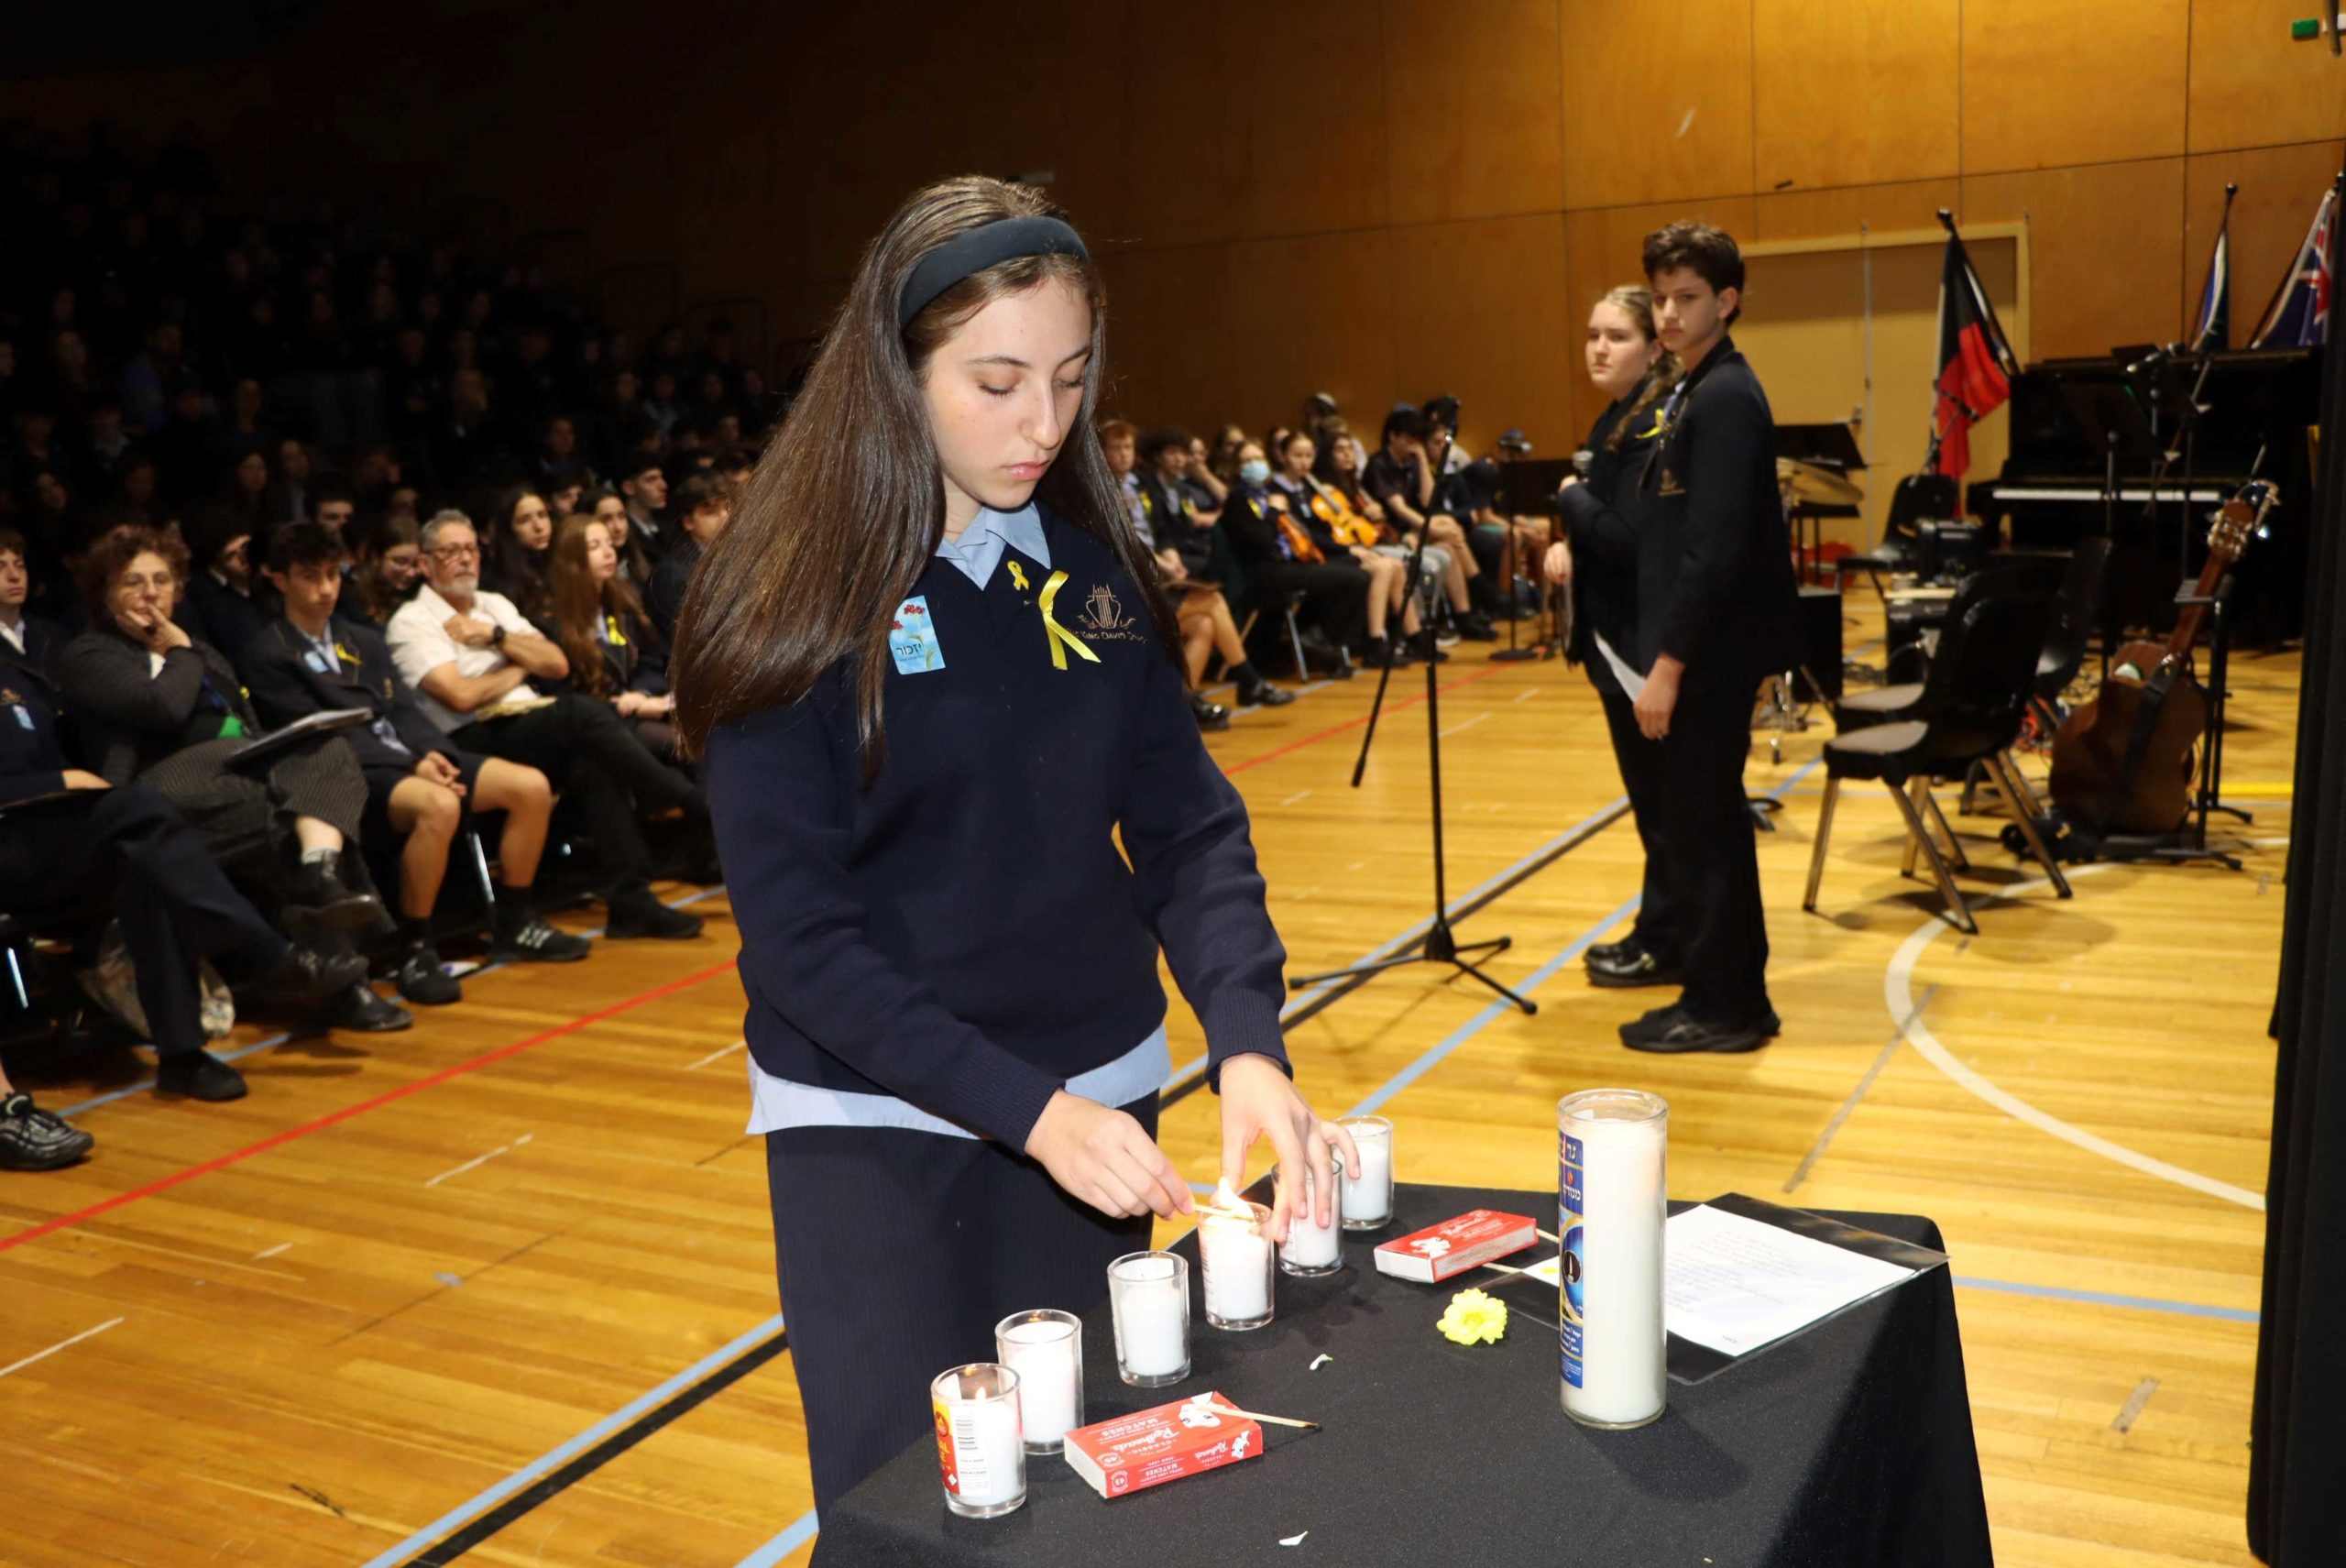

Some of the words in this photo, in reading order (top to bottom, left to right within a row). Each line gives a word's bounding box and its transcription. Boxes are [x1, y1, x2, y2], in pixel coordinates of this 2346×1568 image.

[1101, 631, 1126, 640] DAVID
[895, 643, 922, 656] יזכור
[1101, 1418, 1158, 1437] MATCHES
[1112, 1426, 1179, 1453] Redheads
[1146, 1463, 1178, 1476] MATCHES
